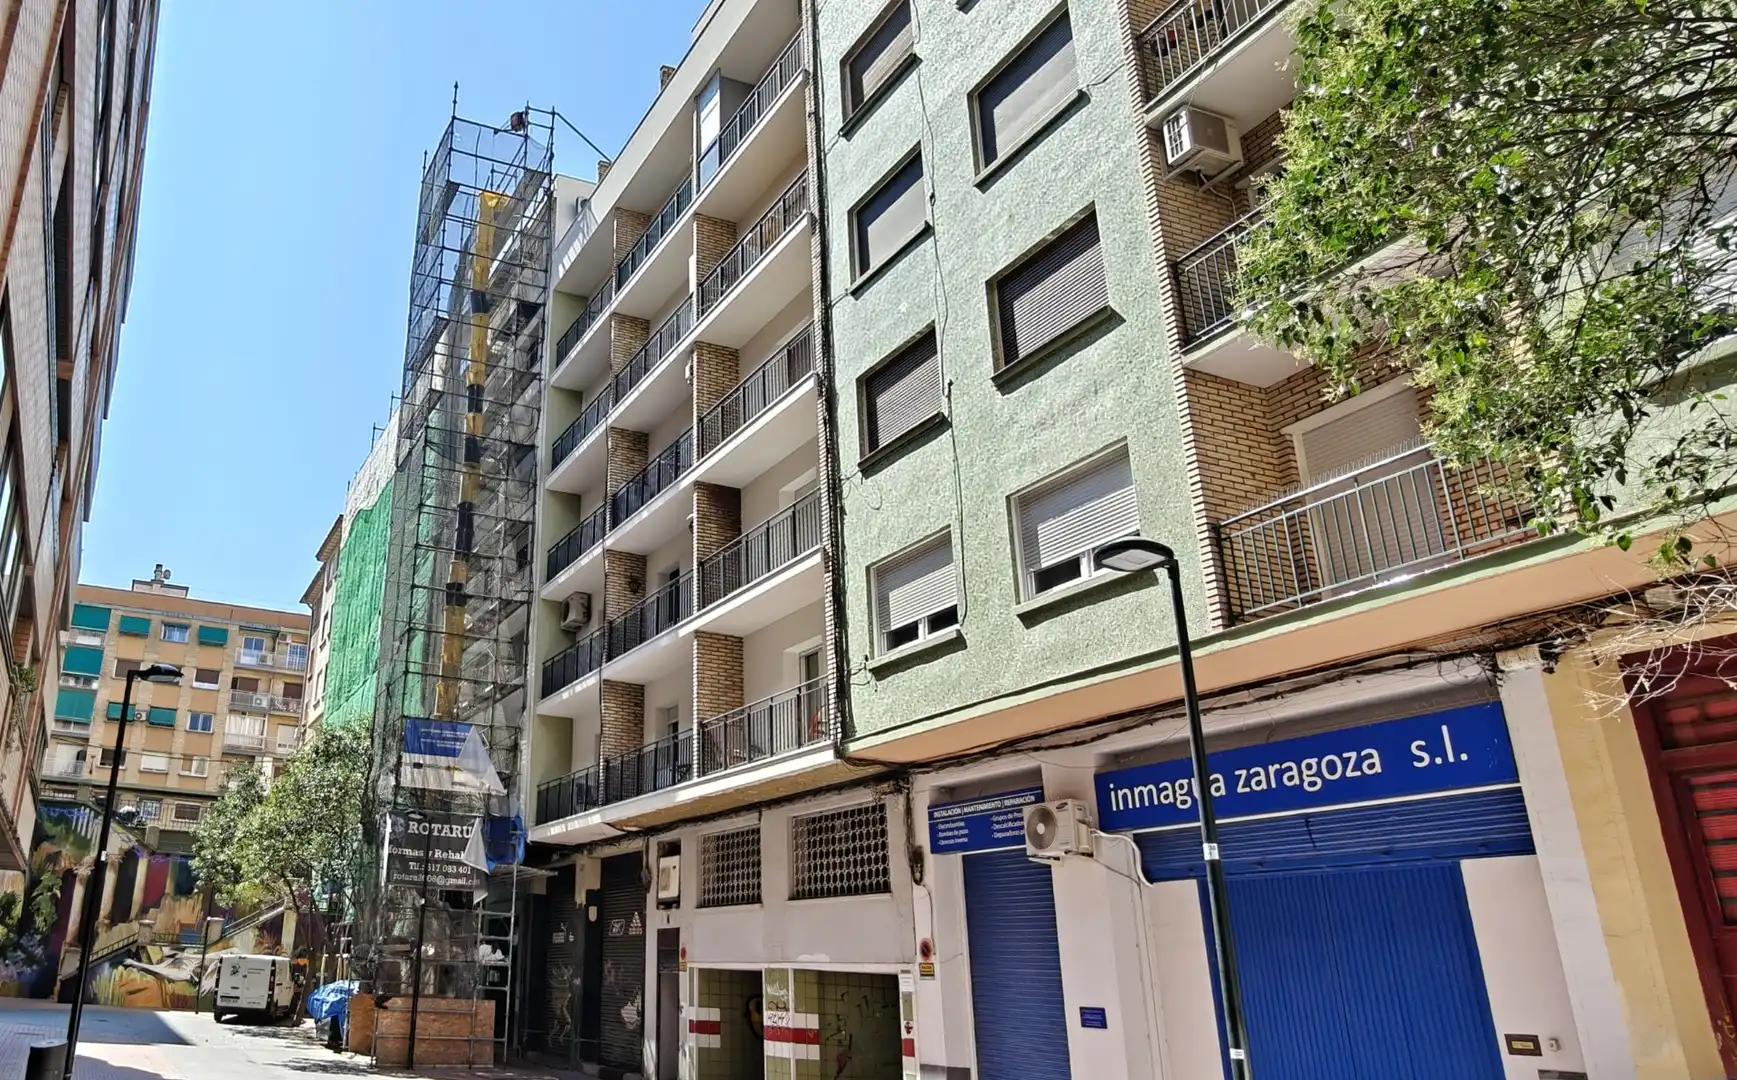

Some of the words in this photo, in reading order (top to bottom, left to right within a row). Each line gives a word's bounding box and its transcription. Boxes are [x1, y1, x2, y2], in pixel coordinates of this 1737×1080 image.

[1235, 748, 1382, 792] zaragoza
[1411, 725, 1468, 767] s.l.
[964, 801, 1001, 813] MANTENIMIENTO
[1004, 795, 1035, 806] REPARACIÓN
[407, 821, 473, 839] ROTARU
